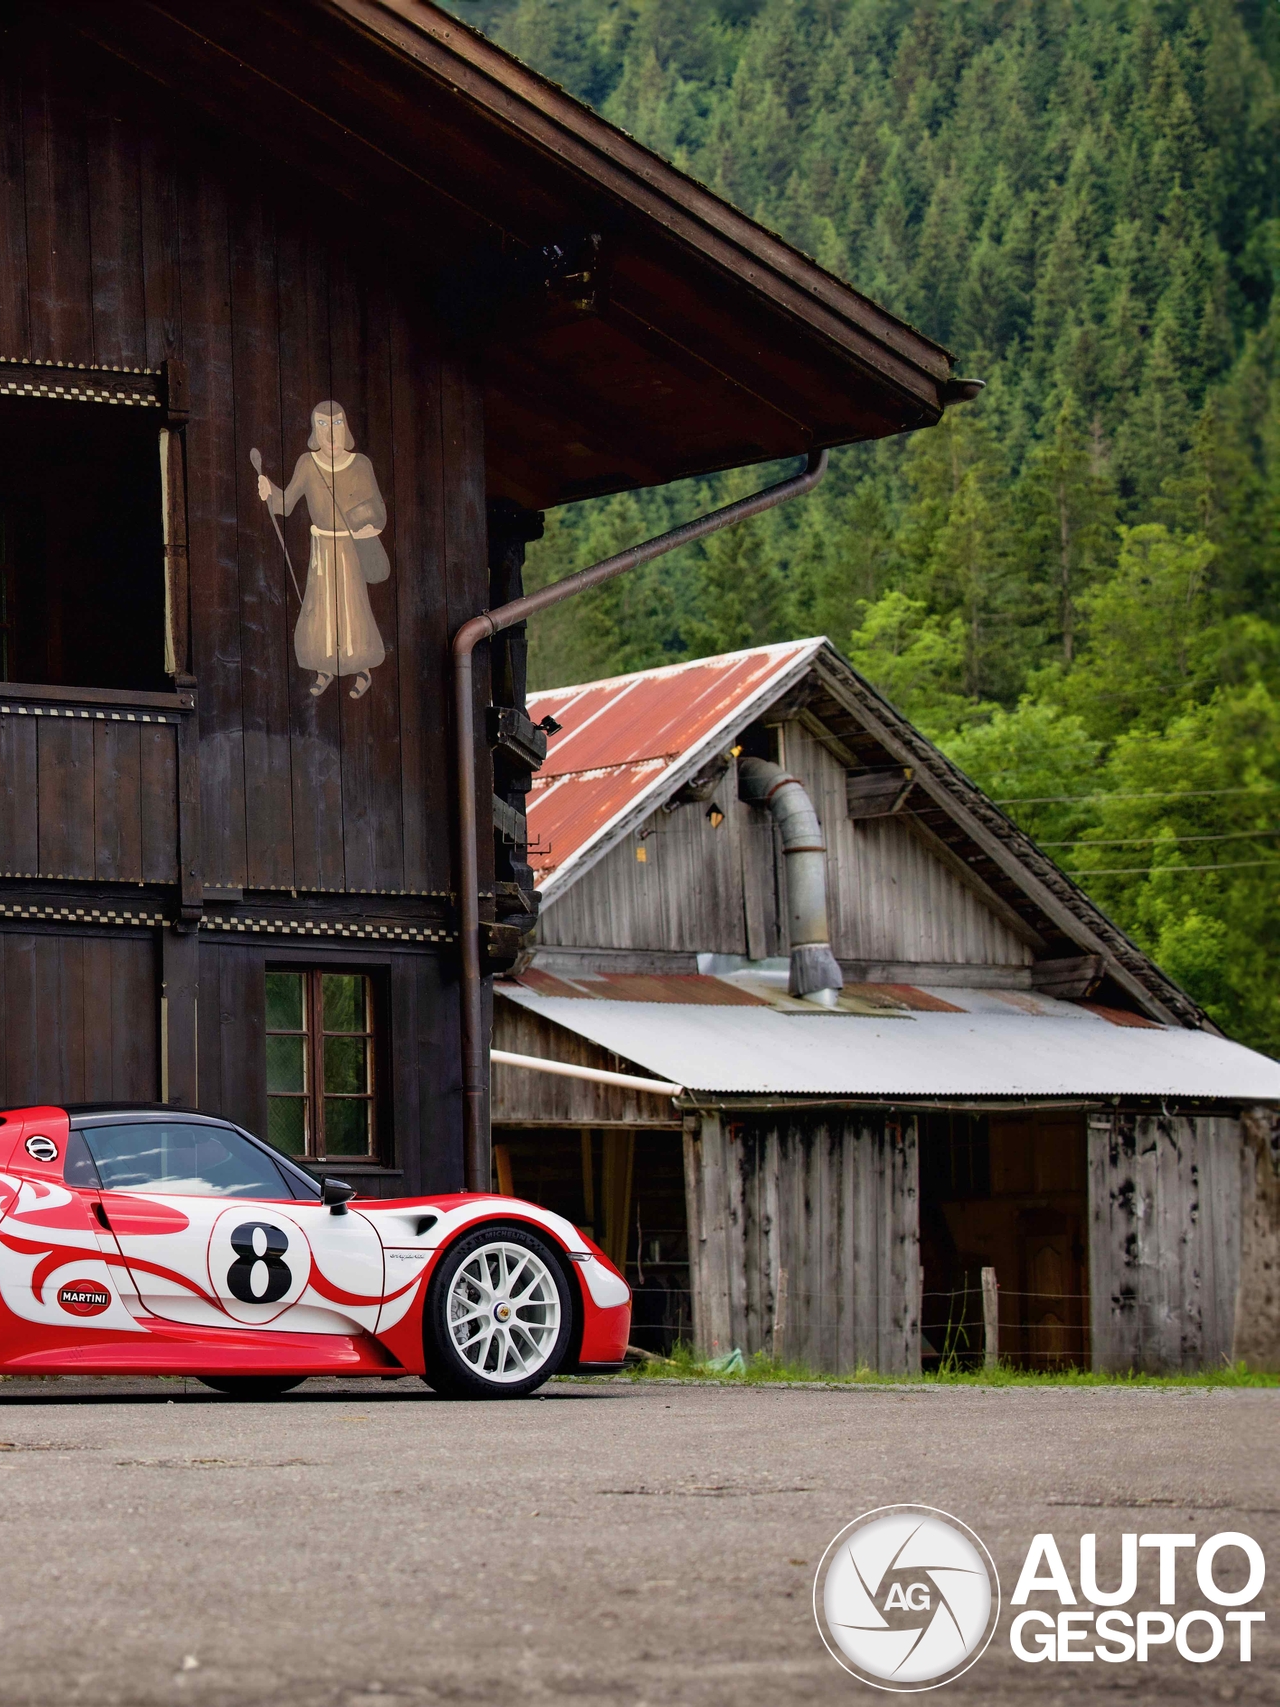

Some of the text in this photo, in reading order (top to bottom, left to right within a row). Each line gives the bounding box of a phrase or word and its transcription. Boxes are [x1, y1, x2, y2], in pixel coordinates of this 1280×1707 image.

[485, 1230, 526, 1241] MICHELIN
[226, 1221, 292, 1304] 8
[62, 1291, 106, 1304] MARTINI
